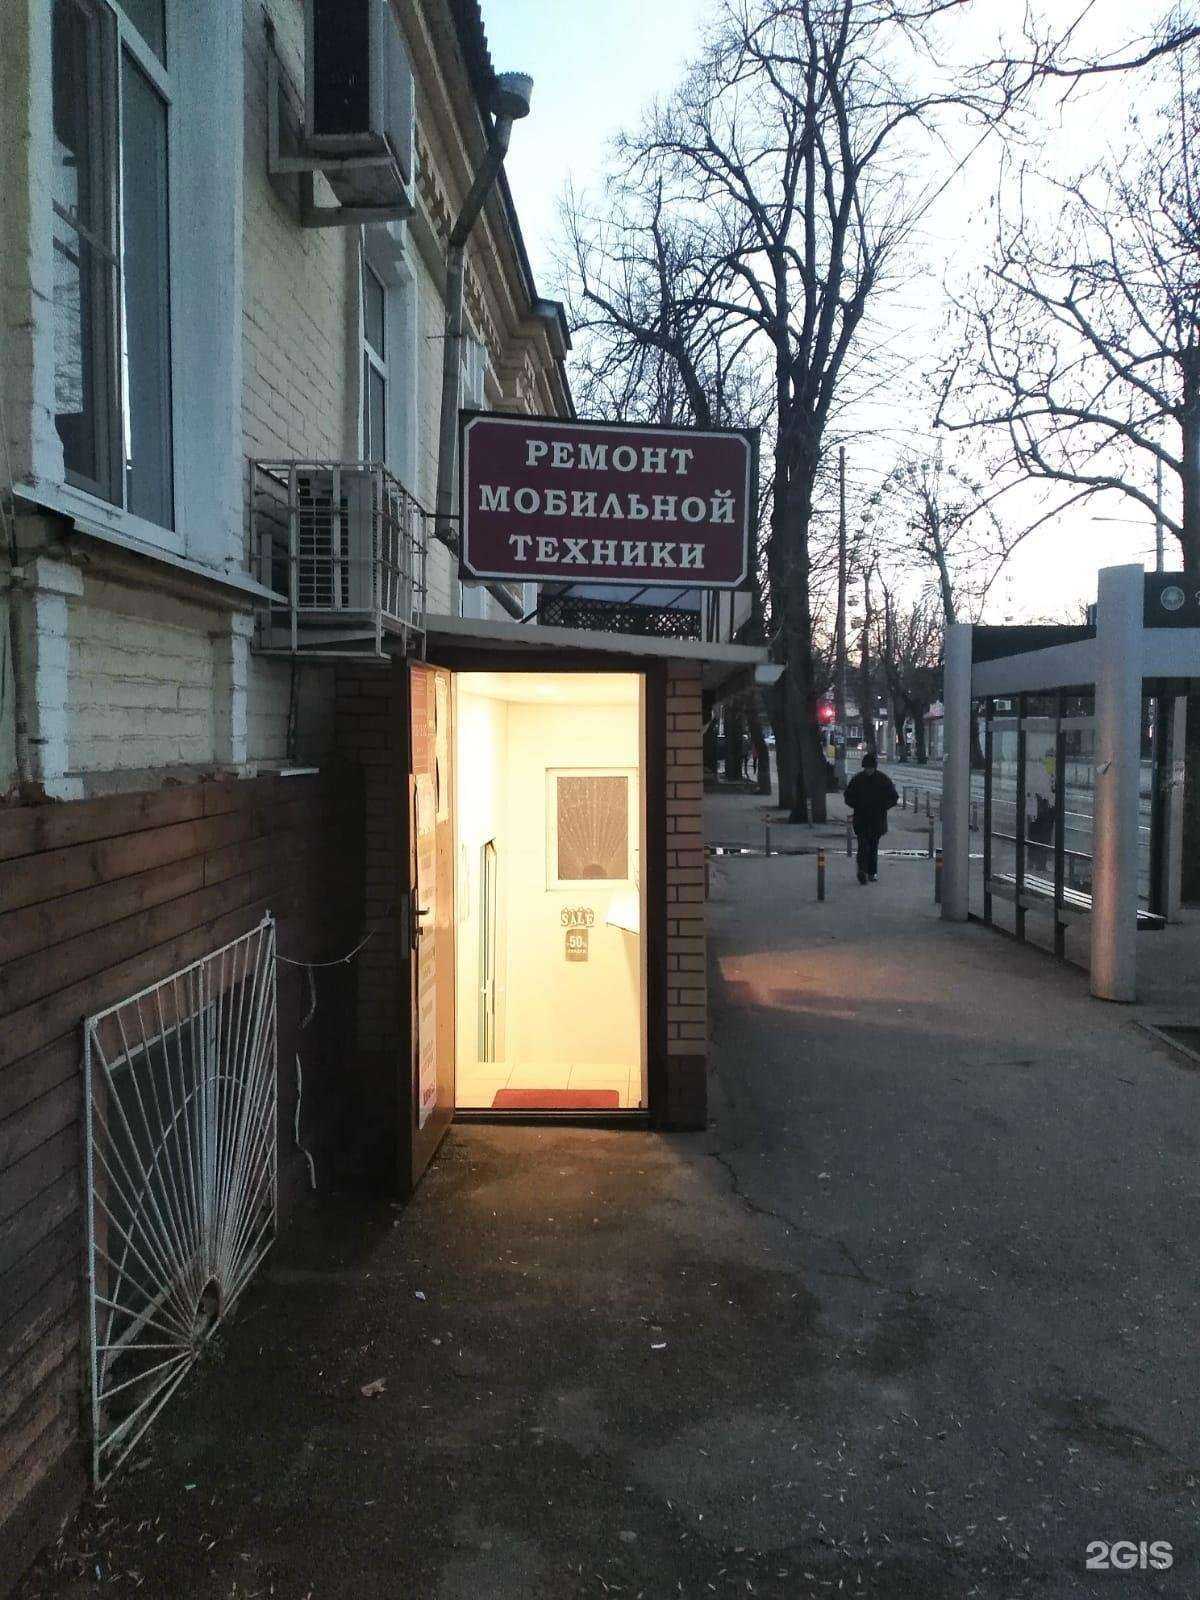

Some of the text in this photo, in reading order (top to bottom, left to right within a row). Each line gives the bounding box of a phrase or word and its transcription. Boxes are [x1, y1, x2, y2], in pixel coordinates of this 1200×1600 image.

[525, 439, 694, 475] РЕМОНТ
[478, 484, 736, 524] МОБИЛЬНОЙ
[508, 533, 705, 569] ТЕХНИКИ
[560, 908, 595, 927] SALE
